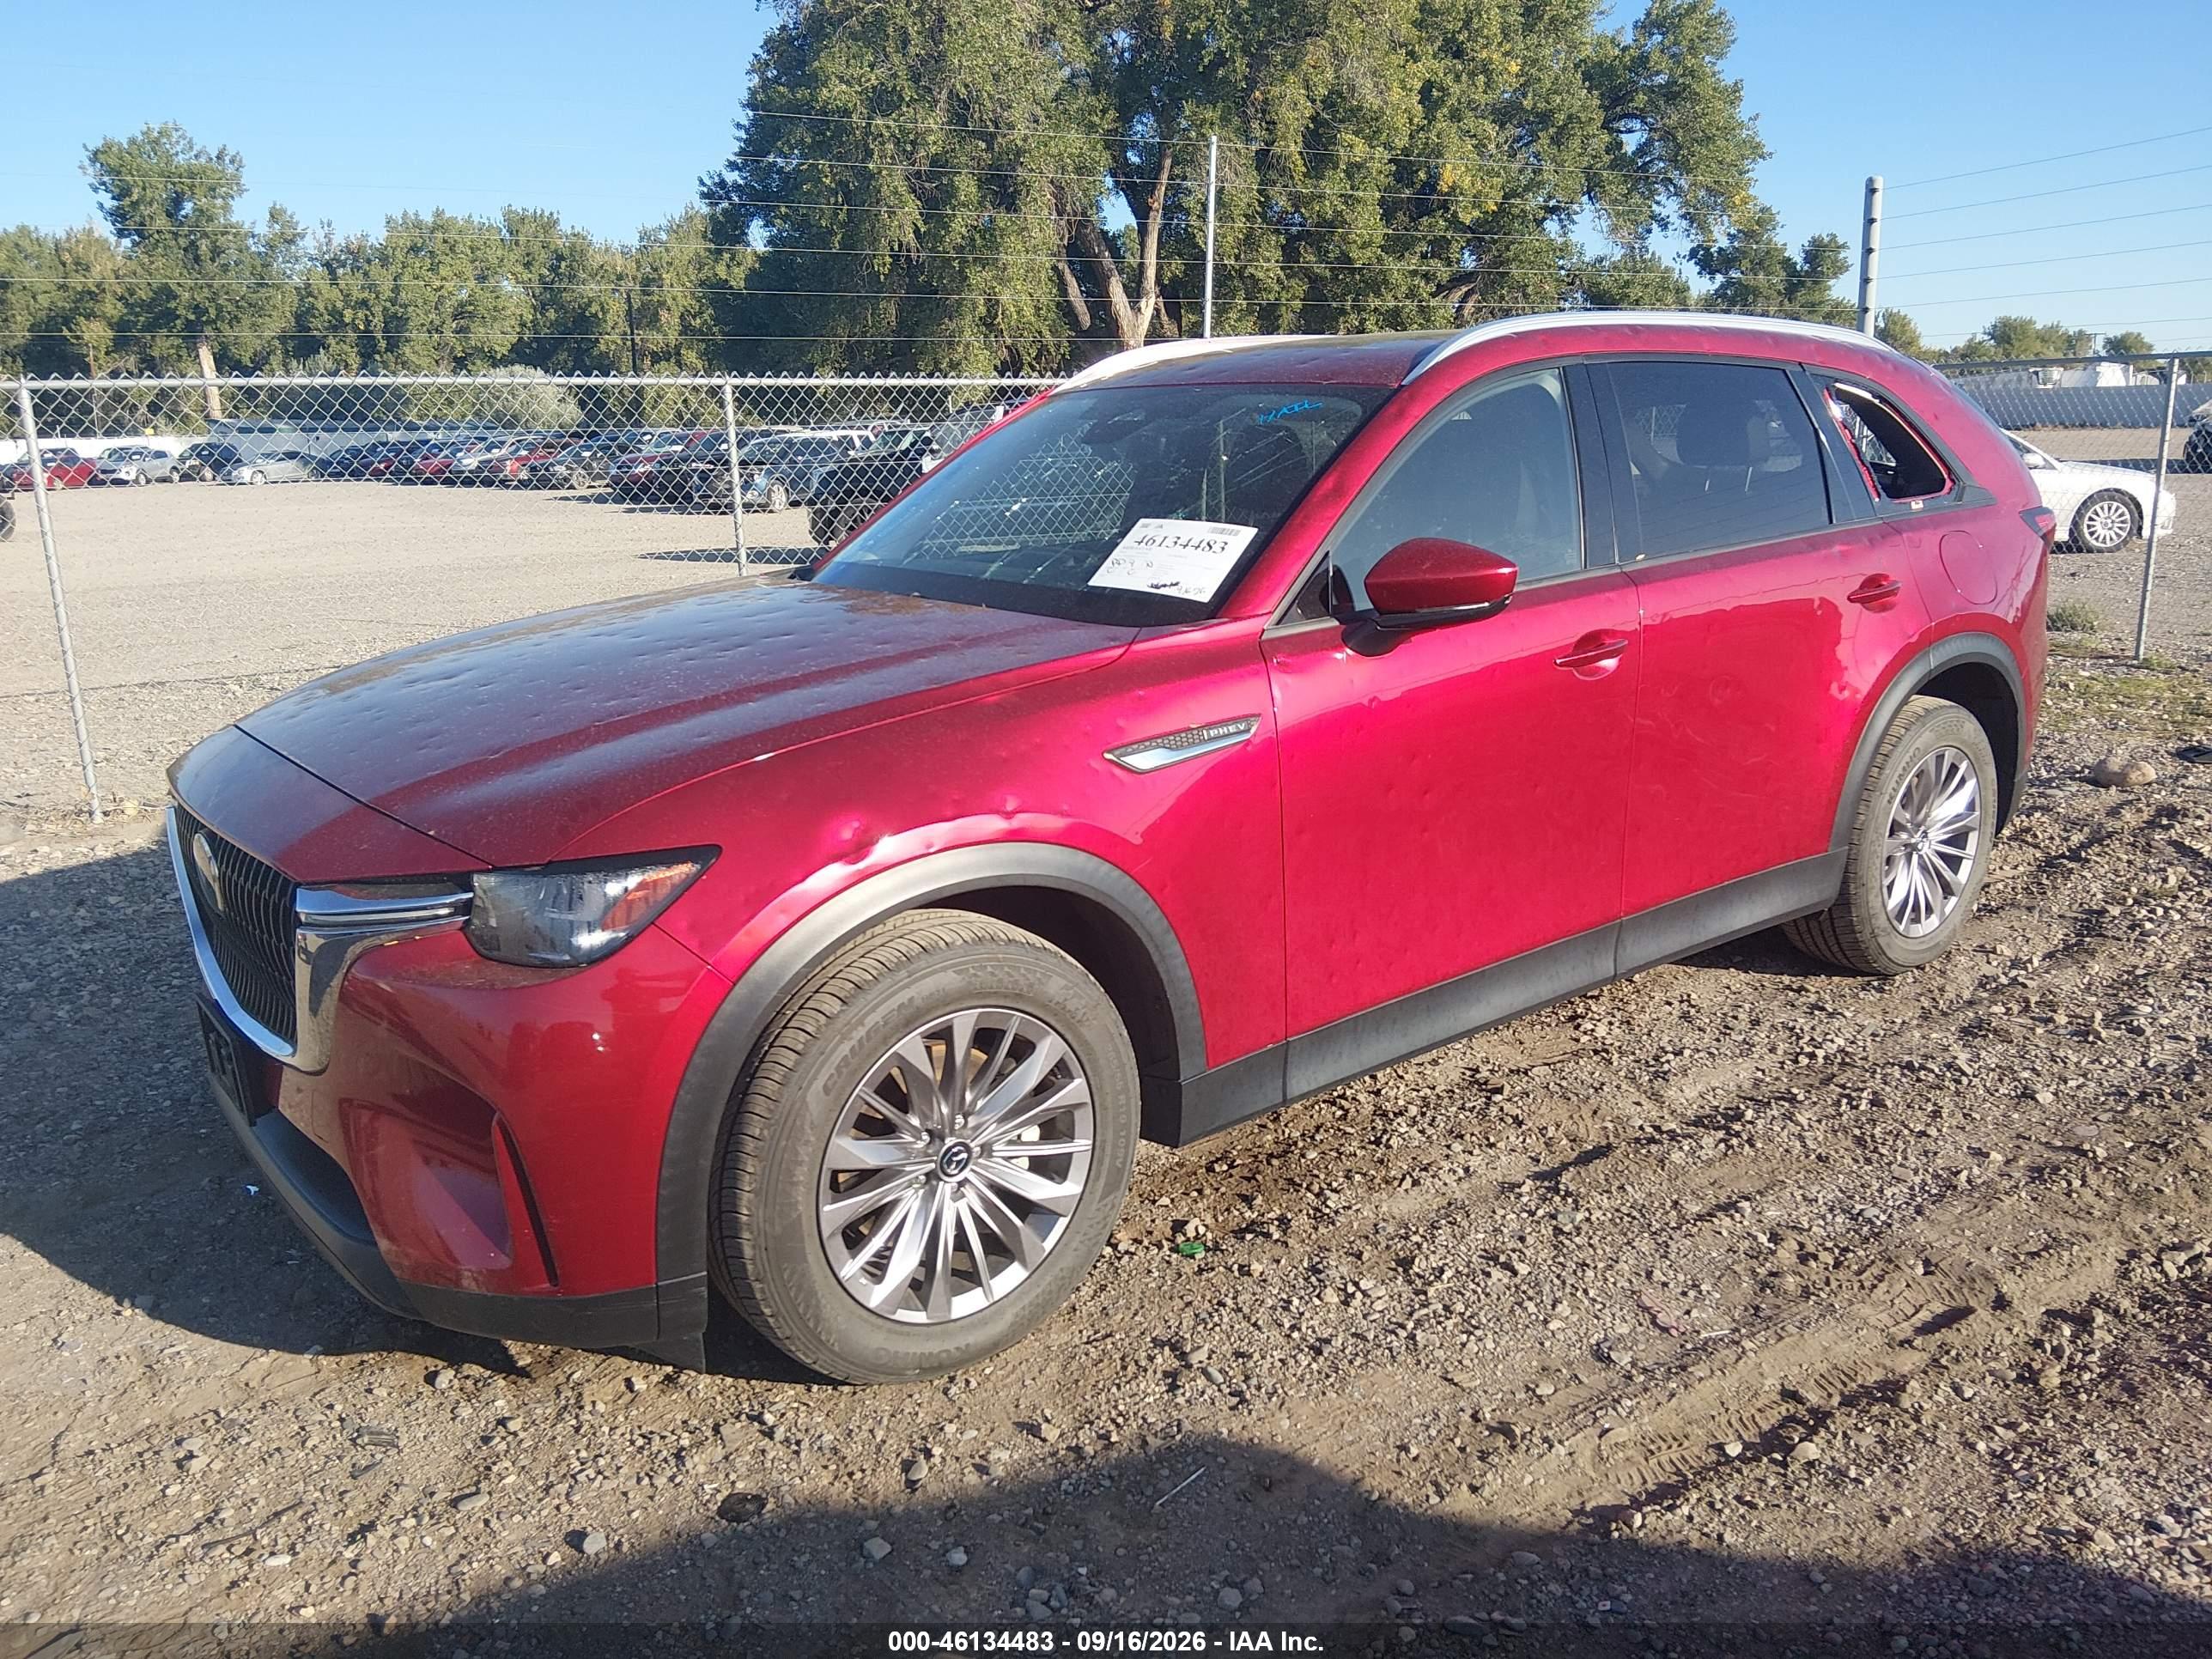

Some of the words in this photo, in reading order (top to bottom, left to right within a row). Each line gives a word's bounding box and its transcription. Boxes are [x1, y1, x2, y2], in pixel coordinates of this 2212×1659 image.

[1133, 533, 1229, 555] 46134483
[1209, 722, 1246, 737] PHEV
[1887, 746, 1921, 805] KUMHO
